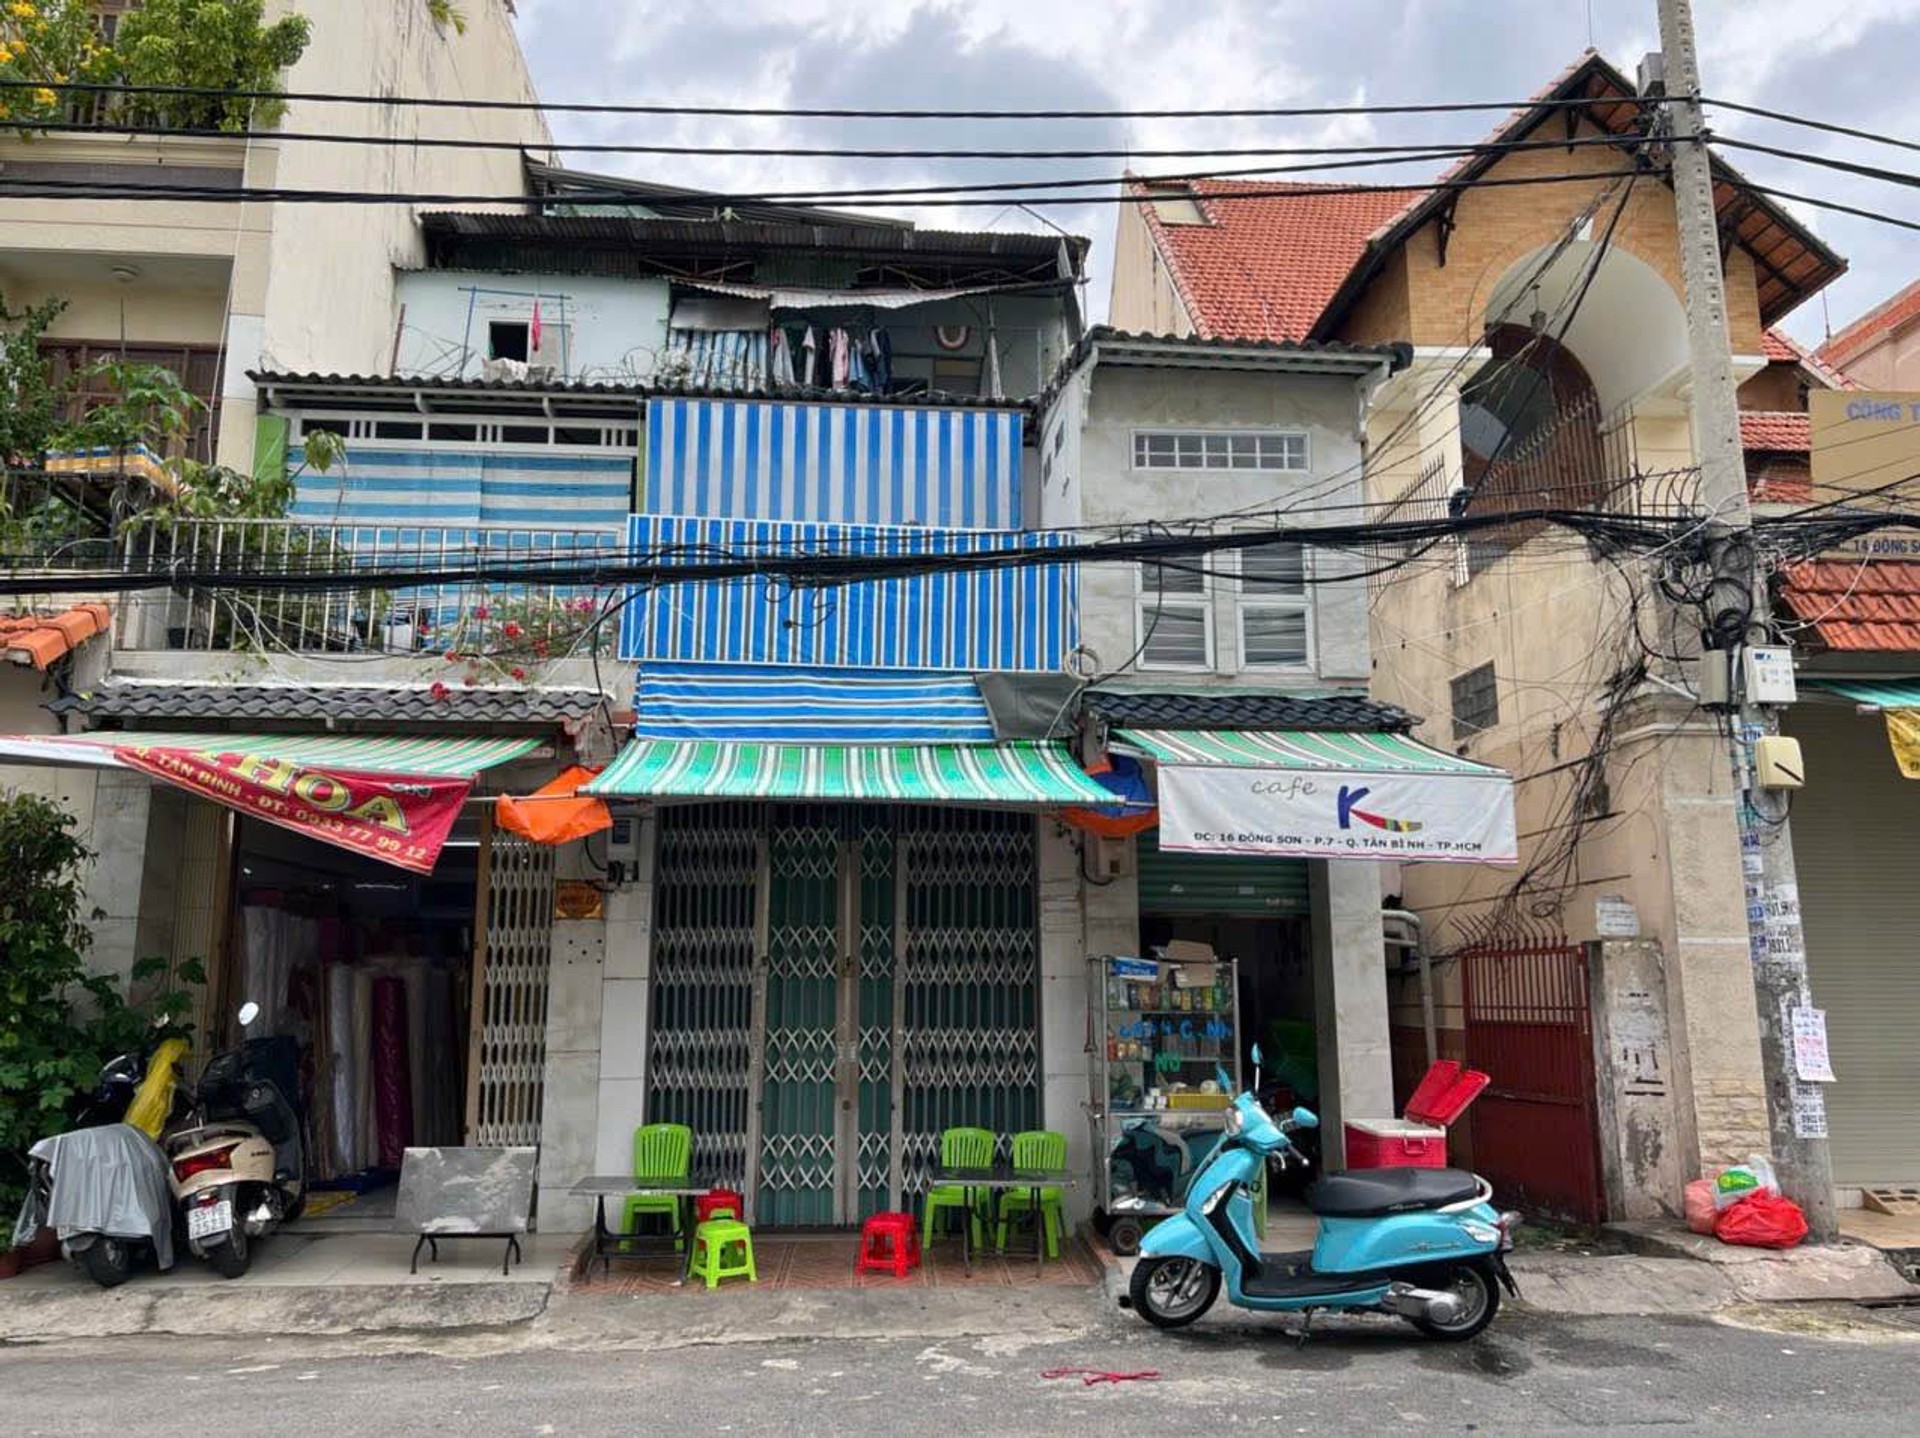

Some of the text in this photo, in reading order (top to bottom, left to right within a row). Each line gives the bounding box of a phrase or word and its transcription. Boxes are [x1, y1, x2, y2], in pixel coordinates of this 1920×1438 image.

[1250, 776, 1318, 801] cafe
[295, 808, 344, 833] 0933
[347, 826, 374, 842] 77
[375, 835, 402, 853] 99
[404, 844, 429, 860] 12
[1219, 832, 1235, 843] 16
[1346, 837, 1361, 849] Q.
